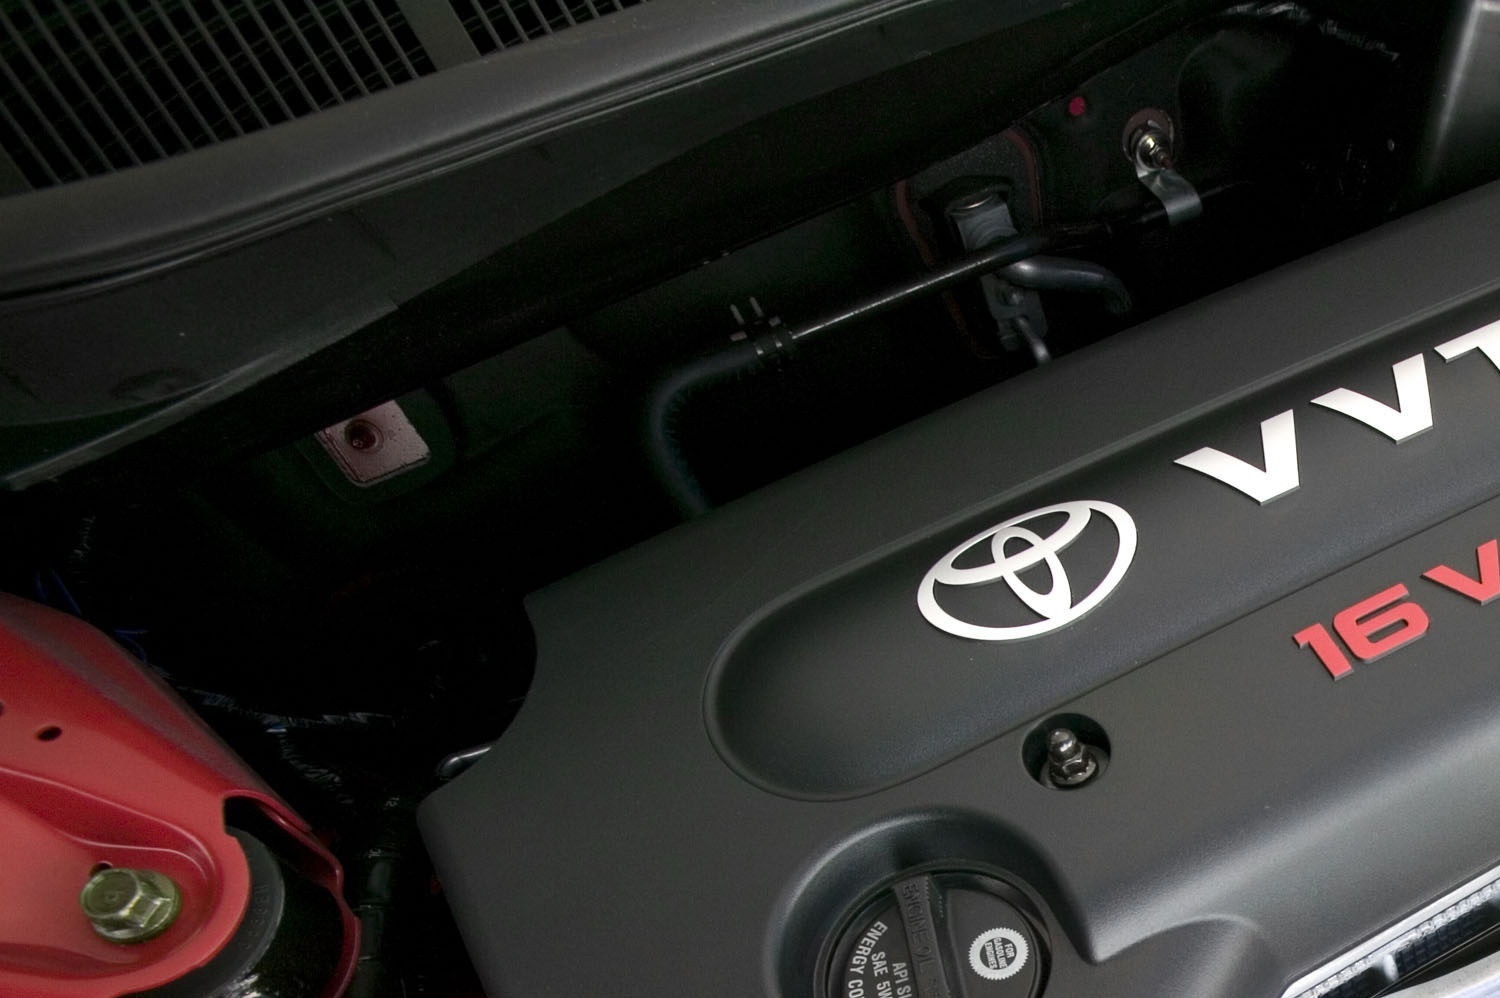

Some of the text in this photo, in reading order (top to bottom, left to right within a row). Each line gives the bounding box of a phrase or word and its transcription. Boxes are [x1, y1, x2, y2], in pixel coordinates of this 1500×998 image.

[1293, 583, 1430, 680] 16
[850, 921, 888, 975] ENERGY
[1004, 943, 1015, 959] FOR
[871, 951, 888, 977] SAE
[892, 961, 908, 983] API
